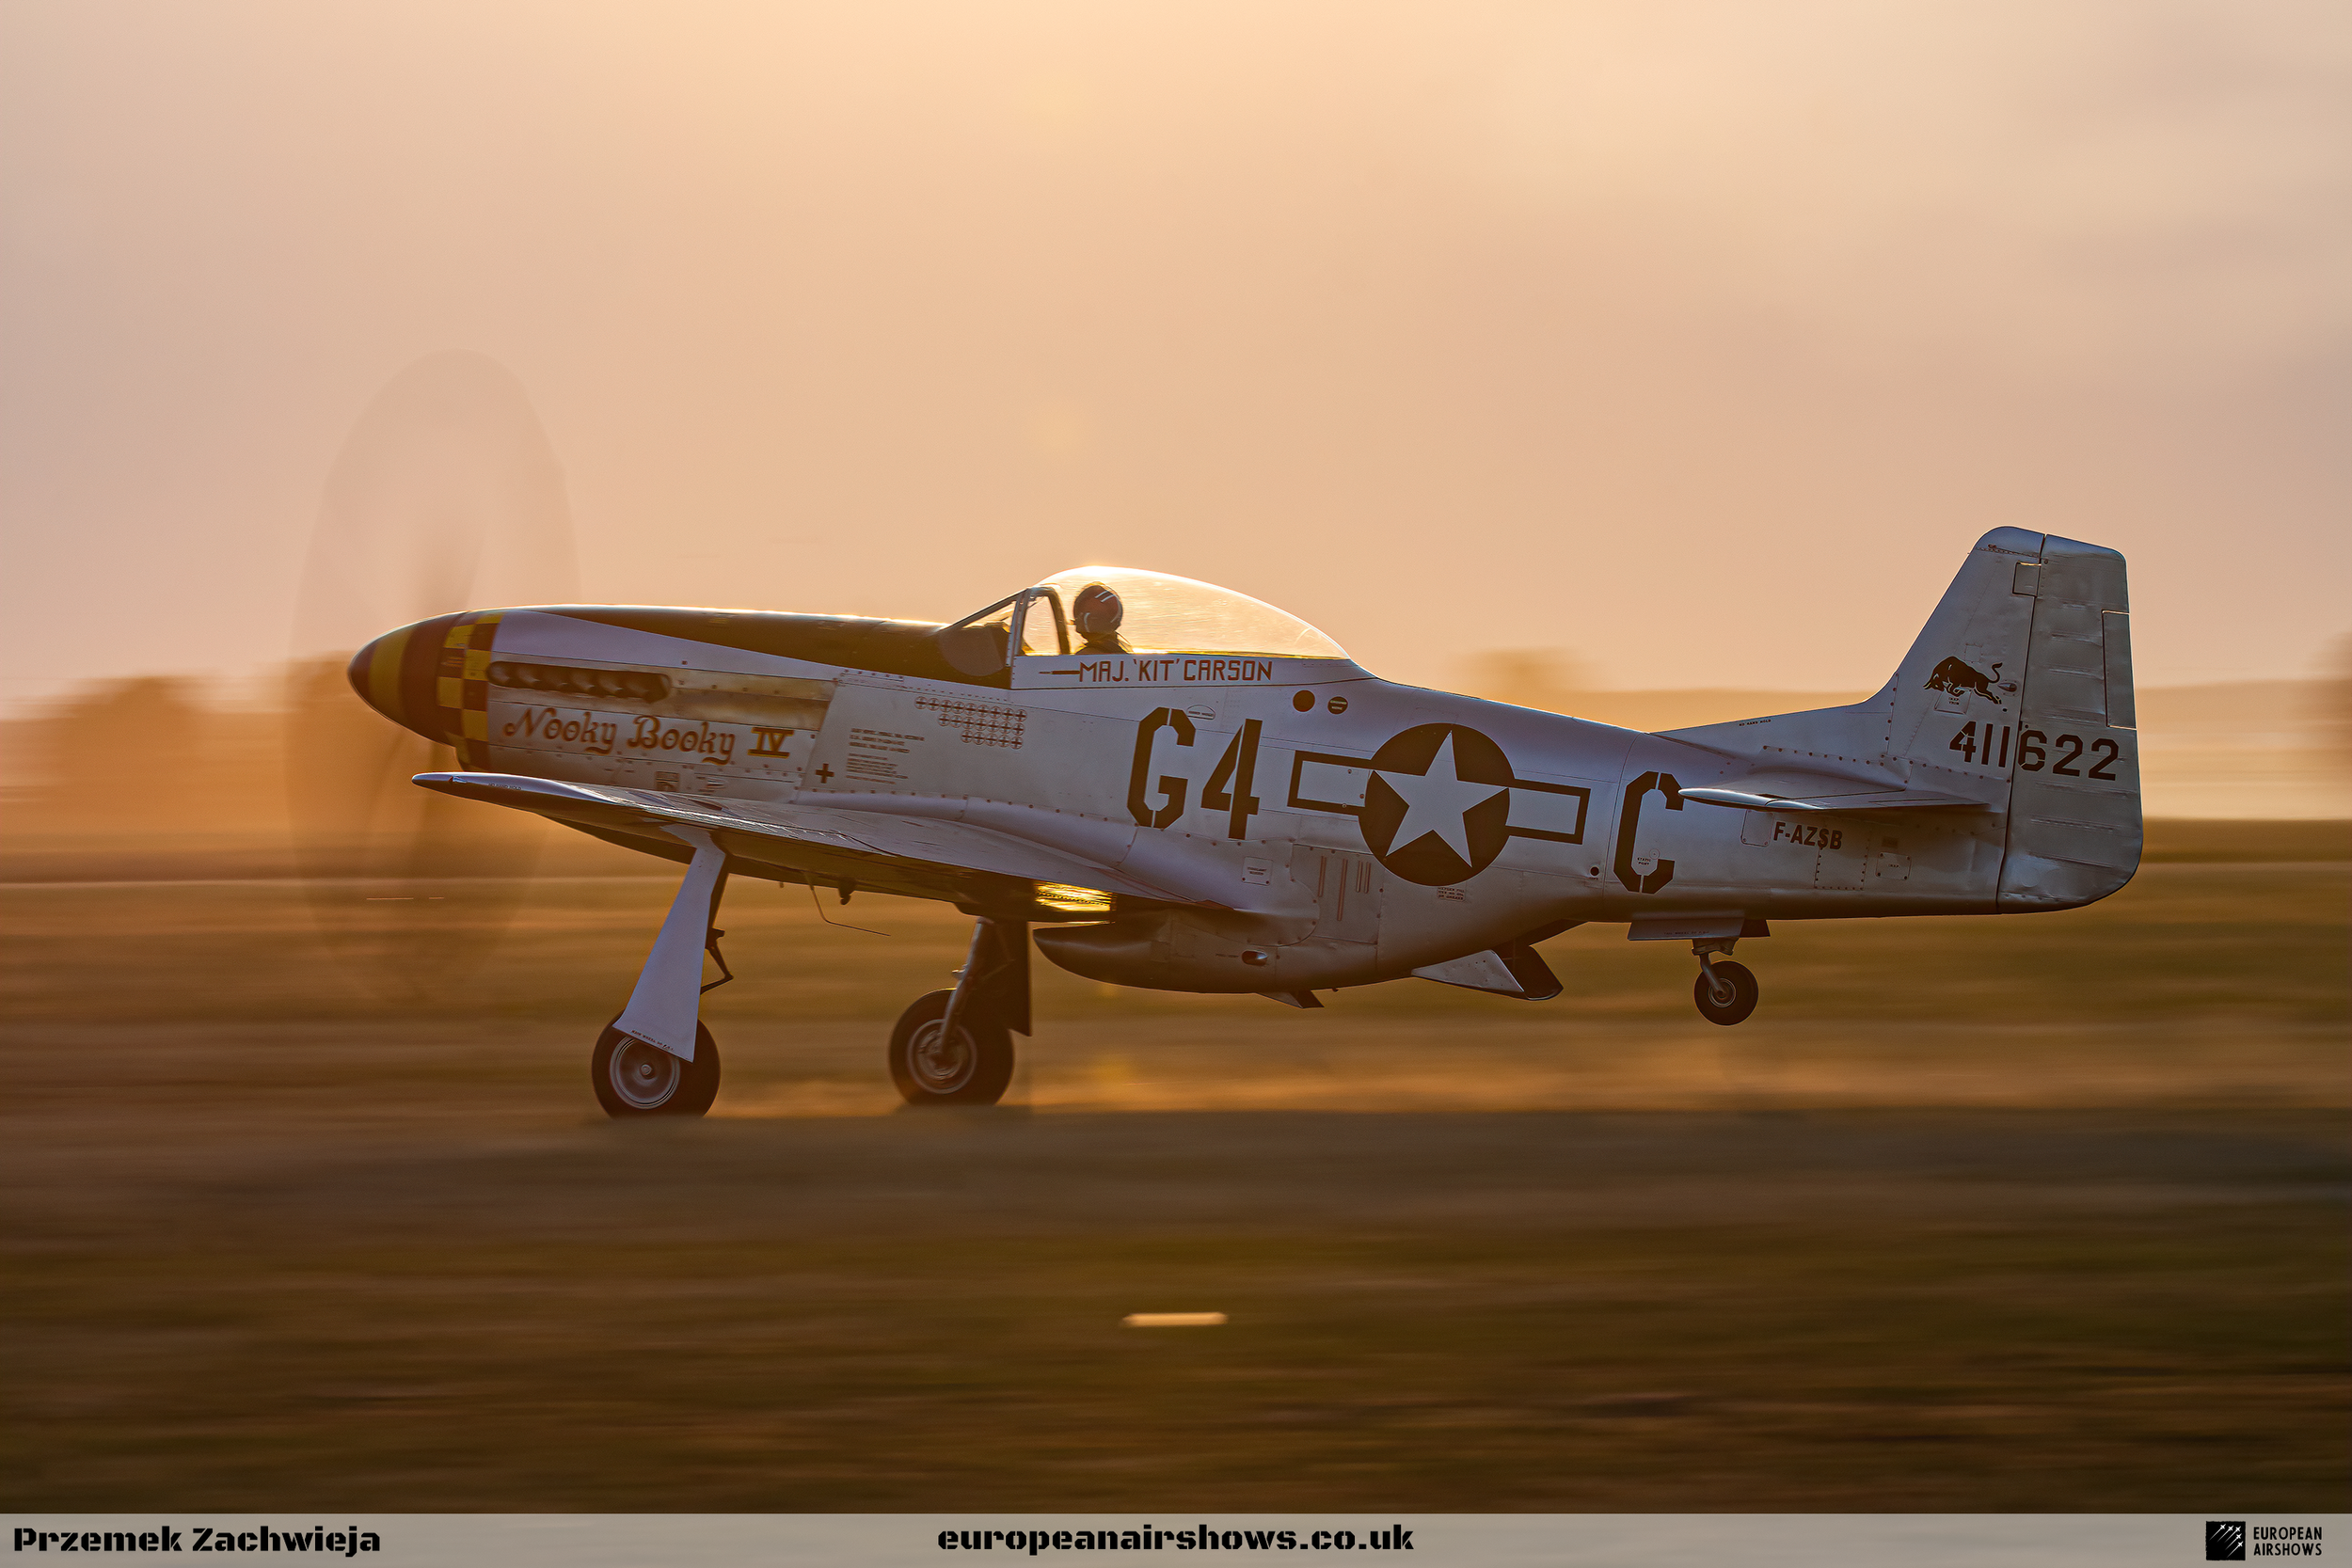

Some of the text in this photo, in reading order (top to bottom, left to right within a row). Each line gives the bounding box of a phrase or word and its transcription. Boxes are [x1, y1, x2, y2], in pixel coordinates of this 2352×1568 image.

[1079, 660, 1129, 682] MAJ.
[1184, 659, 1272, 681] CARSON
[502, 707, 795, 766] Nooky Booky IV
[1949, 721, 2119, 782] 411622
[1127, 706, 1263, 841] G4
[1613, 770, 1685, 895] C
[1773, 821, 1843, 850] F-AZSB
